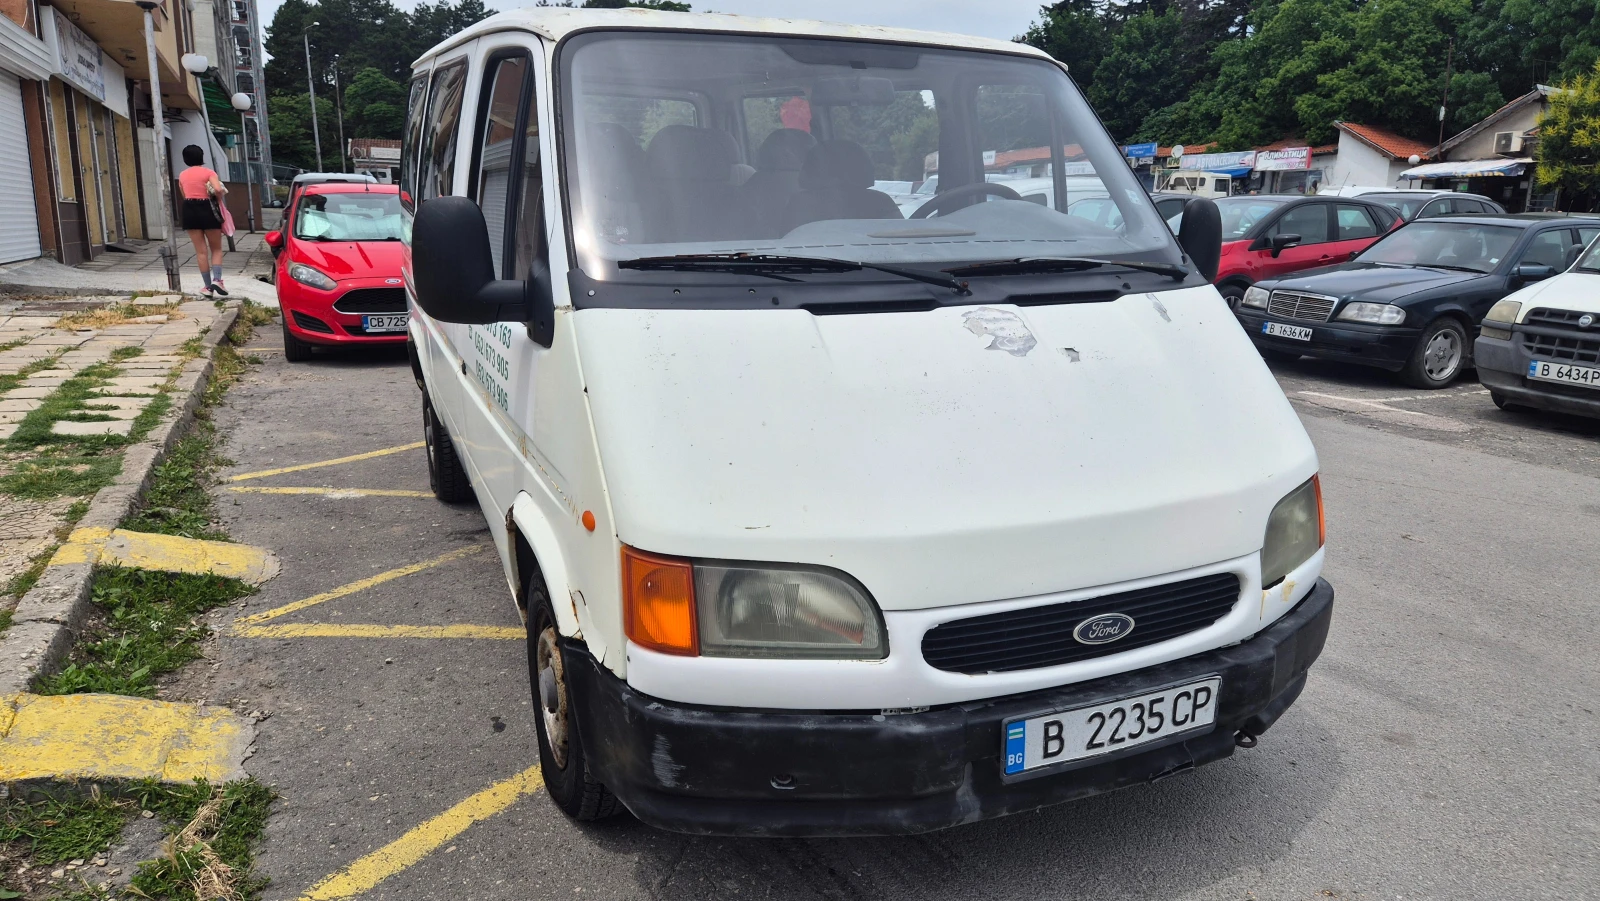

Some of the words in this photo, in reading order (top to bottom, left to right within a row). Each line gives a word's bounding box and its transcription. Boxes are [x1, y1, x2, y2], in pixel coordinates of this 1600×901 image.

[1264, 149, 1307, 160] КЛИМАТИЦИ
[369, 317, 384, 328] CB
[1269, 324, 1276, 334] B
[1279, 325, 1297, 338] 1636
[1297, 328, 1311, 340] KM
[499, 323, 512, 350] 163
[496, 353, 509, 382] 905
[1541, 364, 1550, 377] B
[1556, 366, 1589, 383] 6434
[496, 384, 509, 412] 906
[1088, 619, 1121, 639] Ford
[1042, 718, 1065, 760] B
[1086, 696, 1165, 751] 2235
[1171, 685, 1212, 727] CP
[1007, 752, 1023, 766] BG
